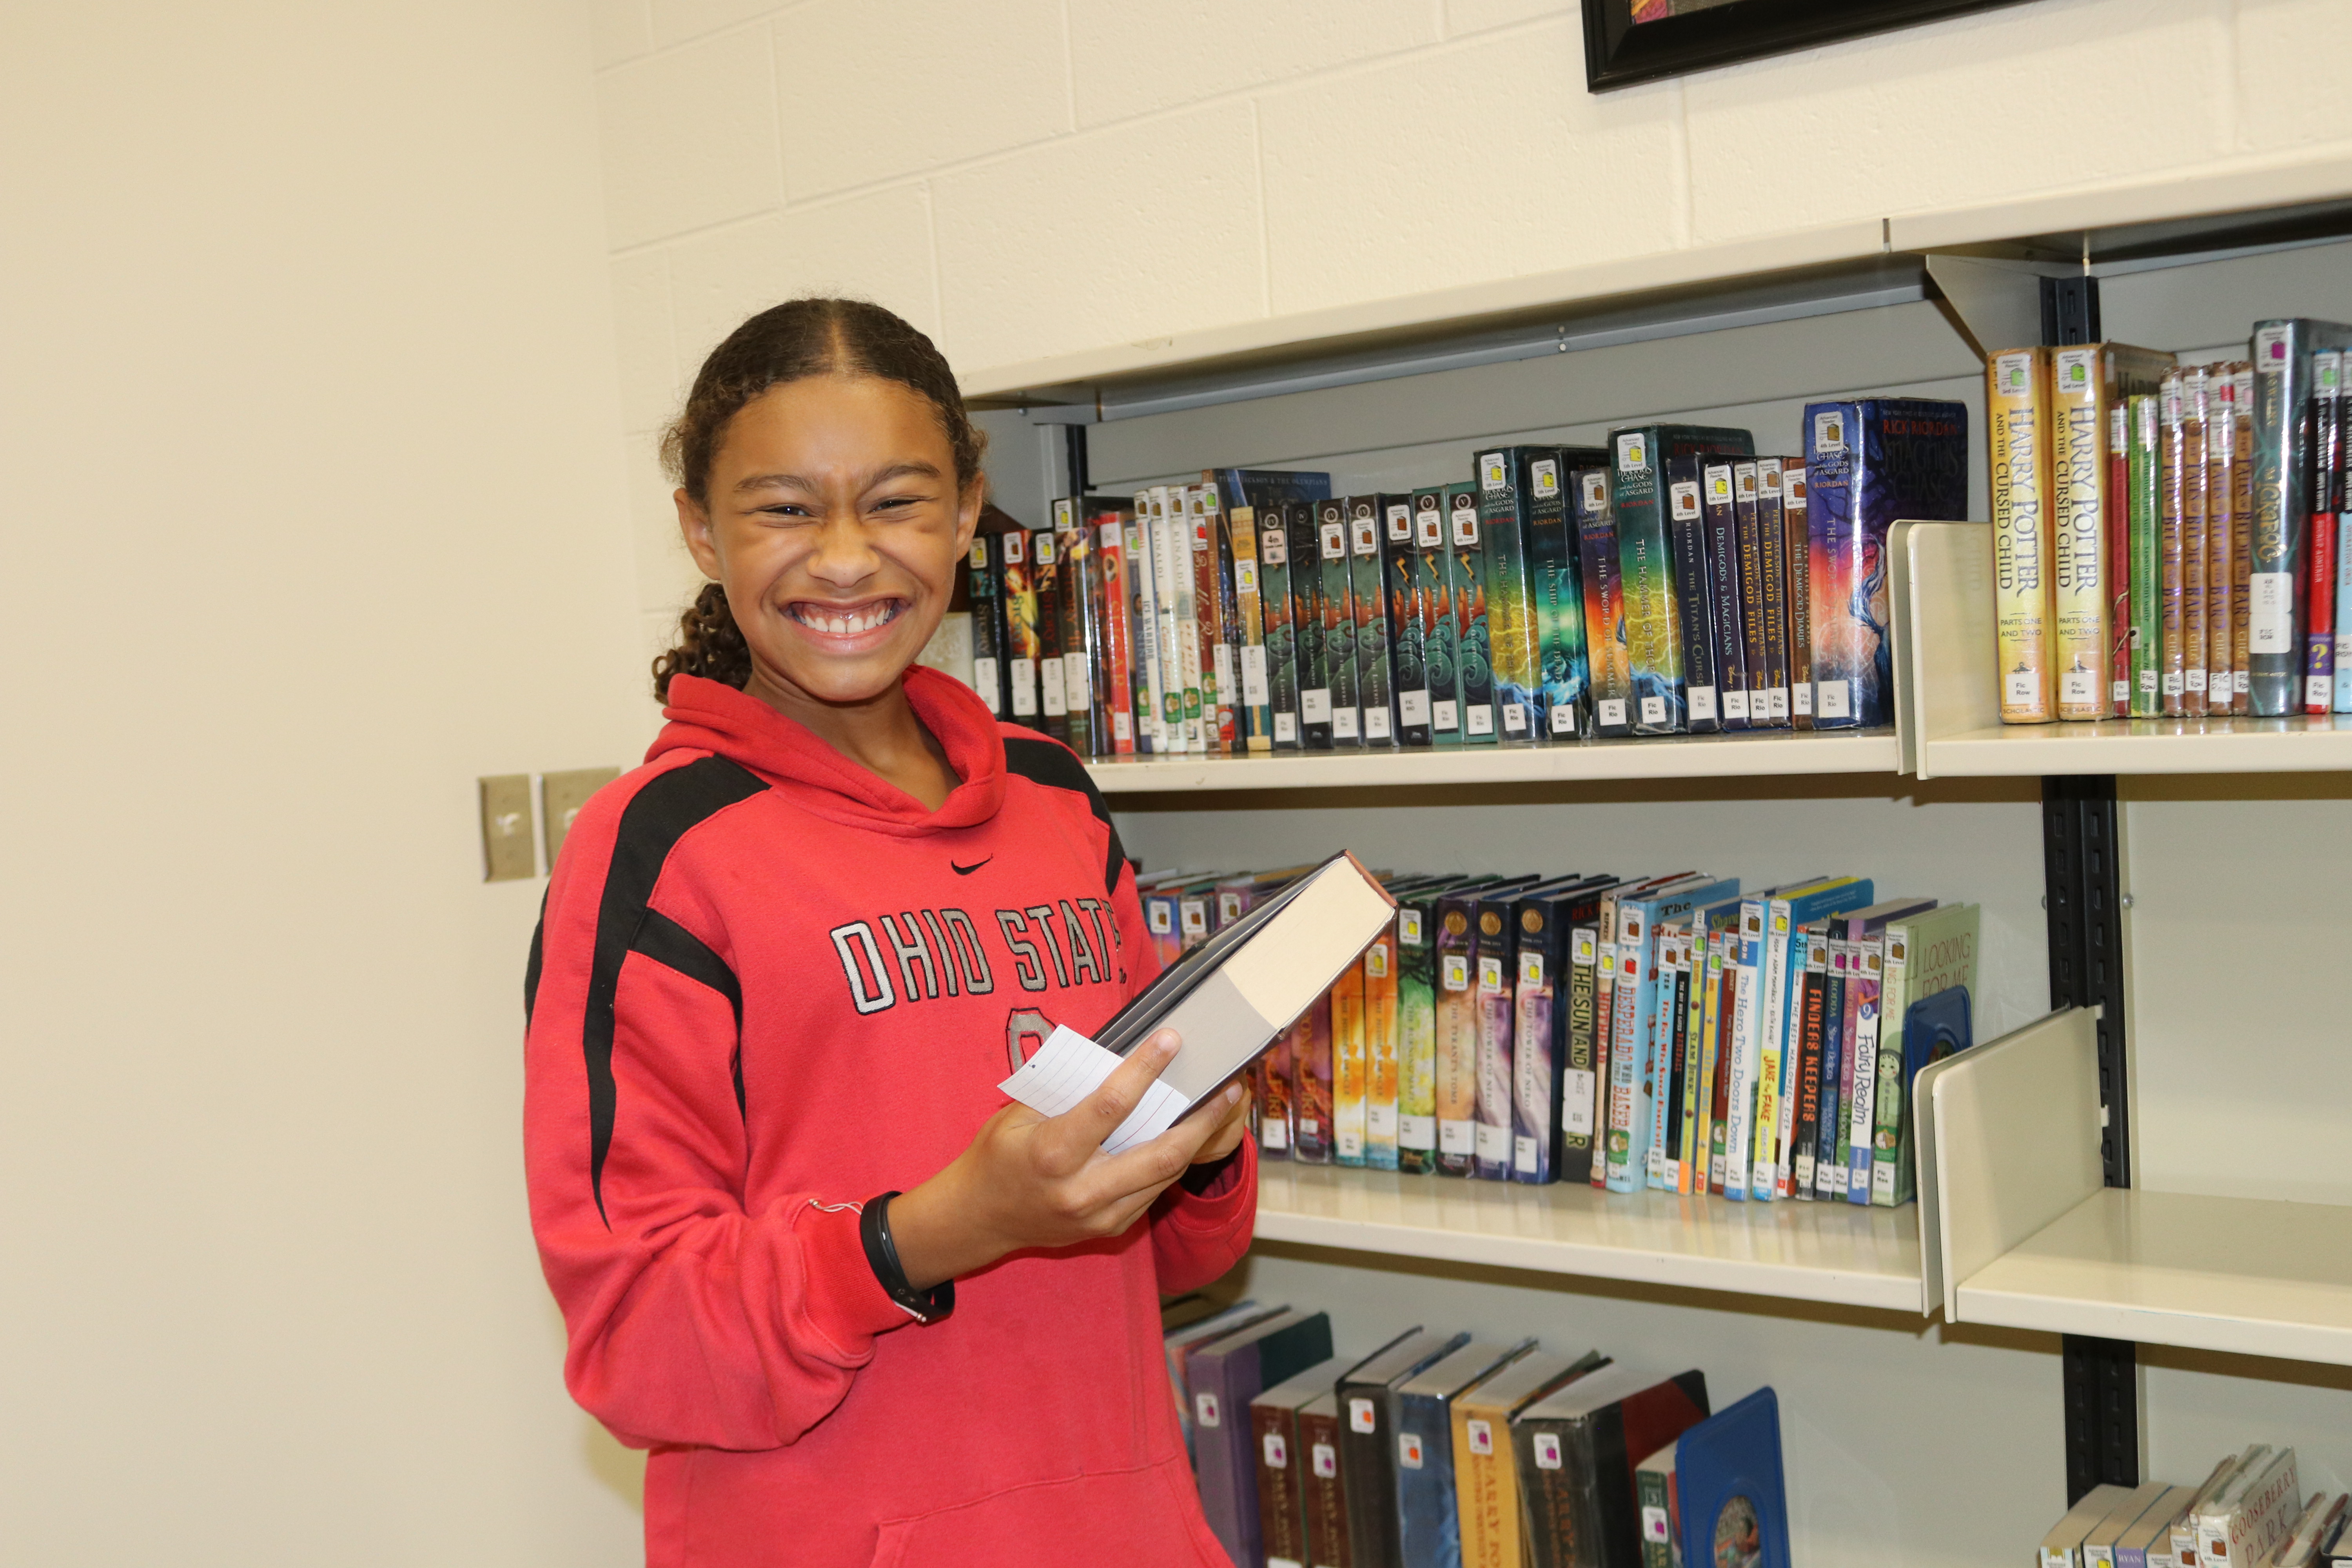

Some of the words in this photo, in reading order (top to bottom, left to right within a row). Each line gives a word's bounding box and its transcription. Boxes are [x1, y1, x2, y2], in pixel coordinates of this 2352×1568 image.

[1883, 420, 1907, 434] RICK
[1911, 421, 1958, 435] RIORDAN
[1996, 413, 2005, 436] AND
[2057, 411, 2065, 434] AND
[1997, 437, 2005, 457] THE
[2008, 406, 2036, 492] HARRY
[2058, 436, 2066, 456] THE
[2069, 405, 2096, 491] HARRY
[1996, 463, 2010, 529] CURSED
[2056, 460, 2070, 528] CURSED
[1635, 539, 1646, 562] THE
[1685, 522, 1694, 563] RIORDAN
[1826, 518, 1837, 544] THE
[2011, 499, 2039, 598] POTTER
[2071, 497, 2099, 596] POTTER
[1154, 530, 1163, 578] RINALDI
[1174, 531, 1185, 586] RINALDI
[1598, 556, 1607, 581] THE
[1716, 527, 1727, 582] DEMIGODS
[1743, 544, 1754, 604] DEMIGOD
[1764, 541, 1774, 602] DEMIGOD
[1827, 548, 1838, 592] SWORD
[1998, 535, 2013, 590] CHILD
[2058, 532, 2071, 588] CHILD
[1600, 584, 1610, 625] SWORD
[1639, 566, 1651, 618] HAMMER
[1793, 563, 1804, 610] DEMIGOD
[1829, 596, 1838, 609] OF
[1643, 622, 1653, 636] OF
[1721, 595, 1732, 655] MAGICIANS
[1748, 611, 1757, 643] FILES
[1767, 609, 1776, 641] FILES
[1794, 612, 1805, 648] DIARIES
[1606, 647, 1616, 697] SUMMER
[1646, 639, 1656, 672] THOR
[1692, 644, 1704, 687] CURSE
[1662, 902, 1691, 916] The
[830, 907, 994, 1015] OHIO
[1923, 933, 1971, 973] LOOKING
[1573, 964, 1591, 993] THE
[1740, 975, 1749, 995] The
[1572, 998, 1592, 1032] SUN
[1662, 1000, 1670, 1018] The
[1736, 997, 1748, 1032] Hero
[1829, 980, 1838, 1018] RODDA
[1596, 991, 1611, 1063] HOTHEAD
[1789, 1023, 1798, 1043] BEST
[1806, 988, 1822, 1051] FINDERS
[1572, 1035, 1590, 1067] AND
[1659, 1043, 1667, 1063] Who
[1734, 1036, 1745, 1065] Two
[1763, 1056, 1776, 1083] JAKE
[1855, 1034, 1874, 1073] Fairy
[1731, 1065, 1744, 1111] Doors
[1785, 1048, 1796, 1103] HALLOWEEN
[1802, 1056, 1819, 1122] KEEPERS
[1761, 1094, 1773, 1122] FAKE
[1783, 1107, 1791, 1131] EVER
[1853, 1076, 1871, 1125] Realm
[1728, 1114, 1742, 1154] Down
[2232, 1468, 2295, 1544] GOOSEBERRY
[2118, 1553, 2141, 1564] RYAN
